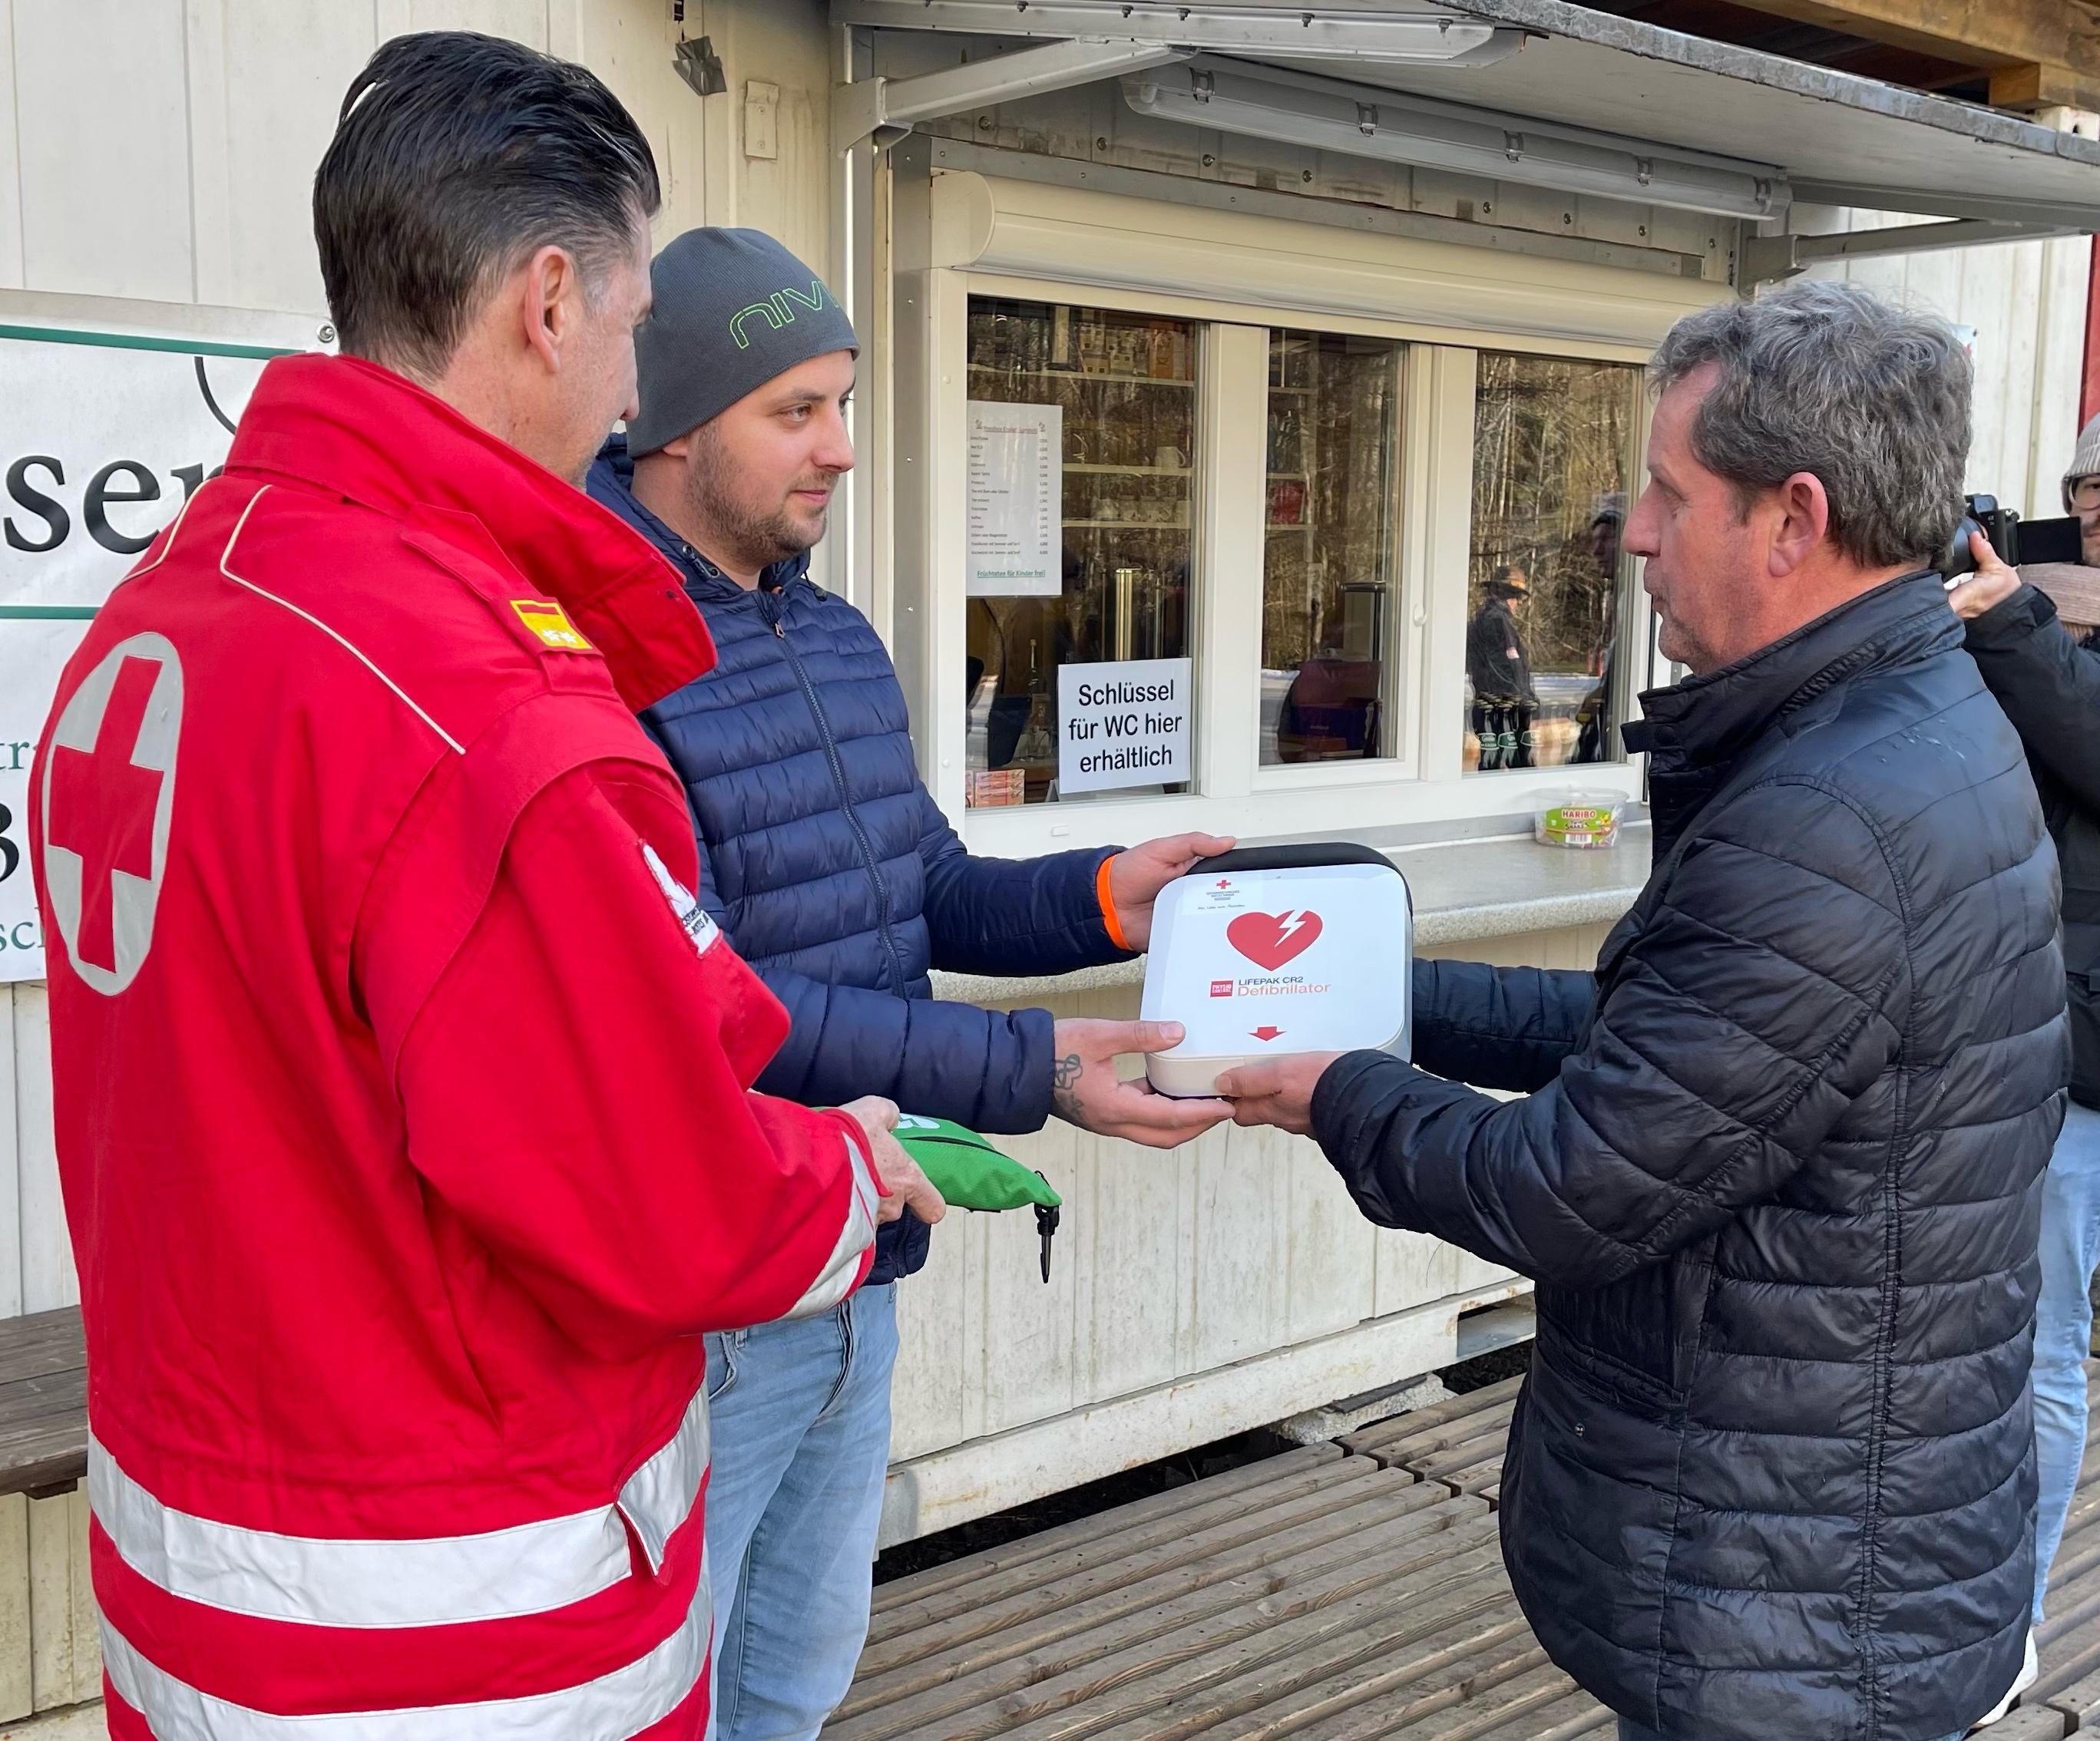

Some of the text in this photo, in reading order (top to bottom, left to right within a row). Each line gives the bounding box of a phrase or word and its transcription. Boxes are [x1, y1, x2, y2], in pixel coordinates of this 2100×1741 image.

[729, 280, 840, 349] niv
[1078, 679, 1174, 706] Schlüssel
[1068, 712, 1182, 740] für WC hier
[1080, 744, 1172, 772] erhältlich
[1562, 810, 1596, 818] HARIBO
[1237, 983, 1331, 996] Defibrillator
[1239, 976, 1304, 986] LIFEPAK CR2
